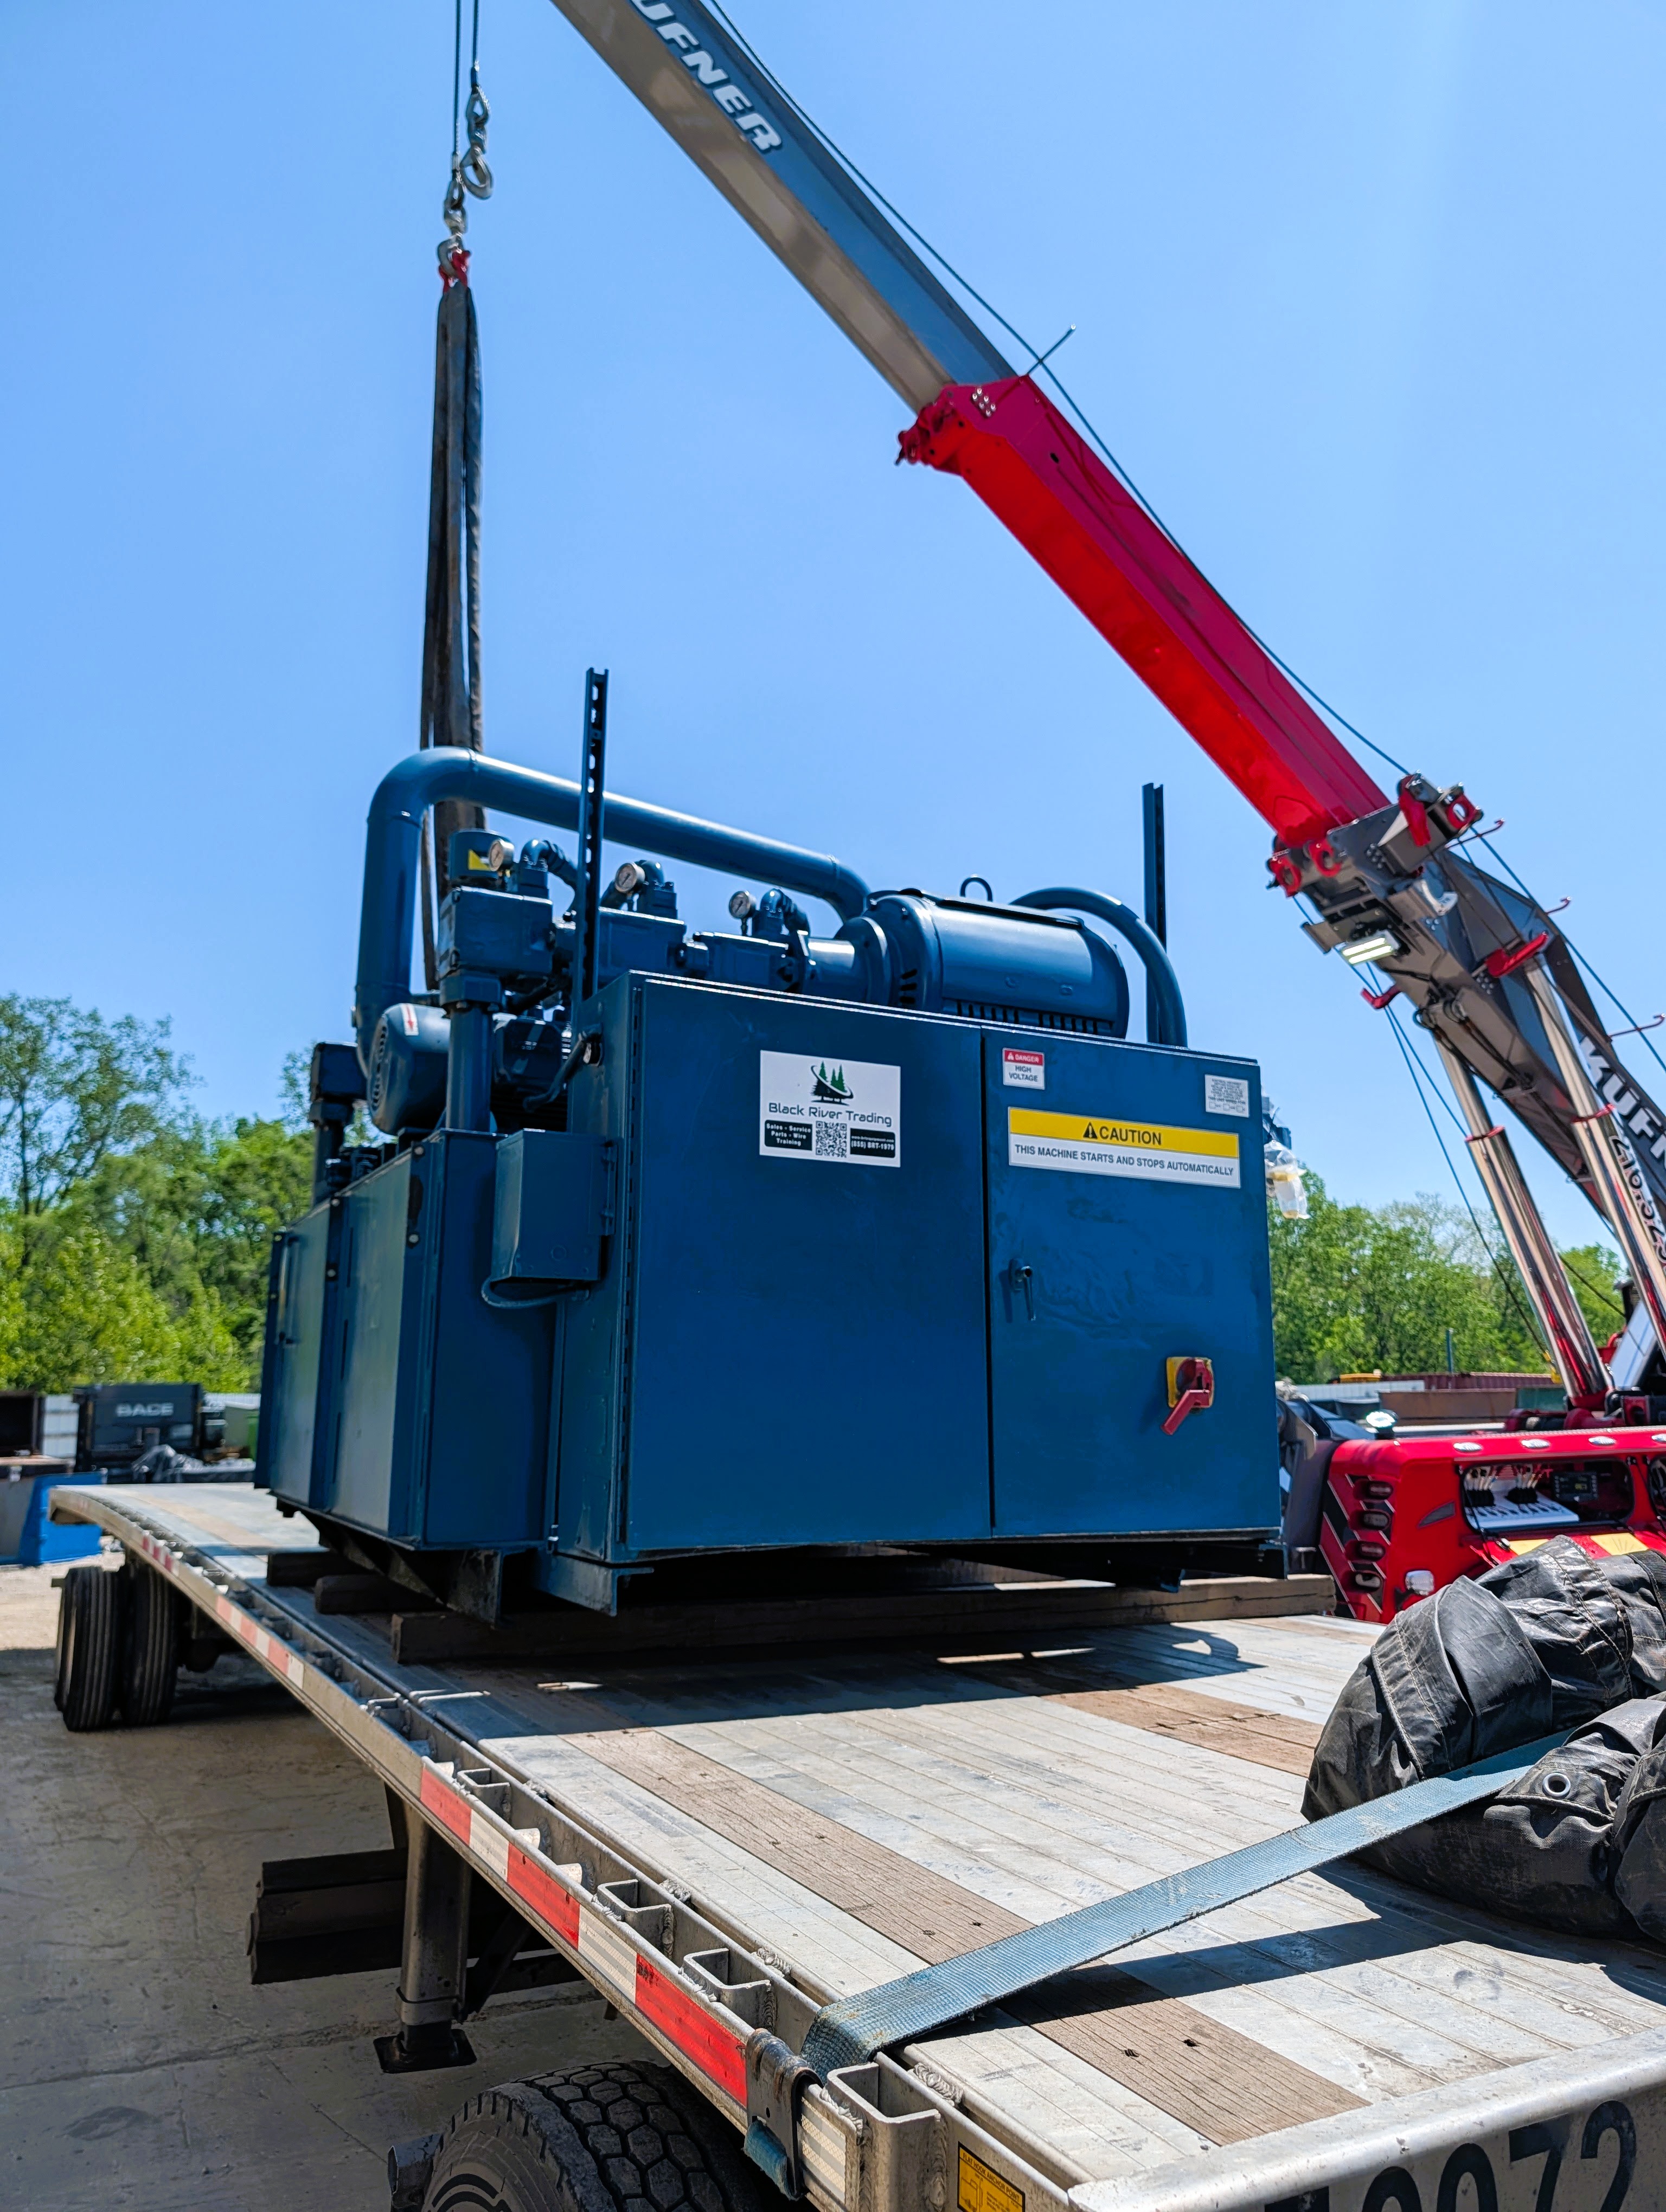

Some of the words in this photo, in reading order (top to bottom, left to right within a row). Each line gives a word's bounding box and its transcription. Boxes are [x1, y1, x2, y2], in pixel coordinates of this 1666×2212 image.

[1015, 1054, 1040, 1063] DANGER
[1015, 1065, 1031, 1073] HIGH
[1009, 1072, 1038, 1082] VOLTAGE
[769, 1102, 805, 1116] Black
[809, 1107, 843, 1119] River
[845, 1110, 892, 1128] Trading
[789, 1125, 811, 1133] Service
[1099, 1126, 1162, 1146] CAUTION
[776, 1137, 802, 1147] Training
[1015, 1144, 1036, 1155] THIS
[1037, 1147, 1078, 1160] MACHINE
[1080, 1152, 1114, 1163] STARTS
[1116, 1155, 1135, 1166] AND
[1137, 1157, 1165, 1169] STOPS
[1167, 1161, 1234, 1176] AUTOMATICALLY
[963, 2152, 973, 2165] FLAT
[973, 2160, 986, 2176] HOOK
[987, 2171, 1005, 2190] ANCHOR
[1006, 2186, 1020, 2202] POINT
